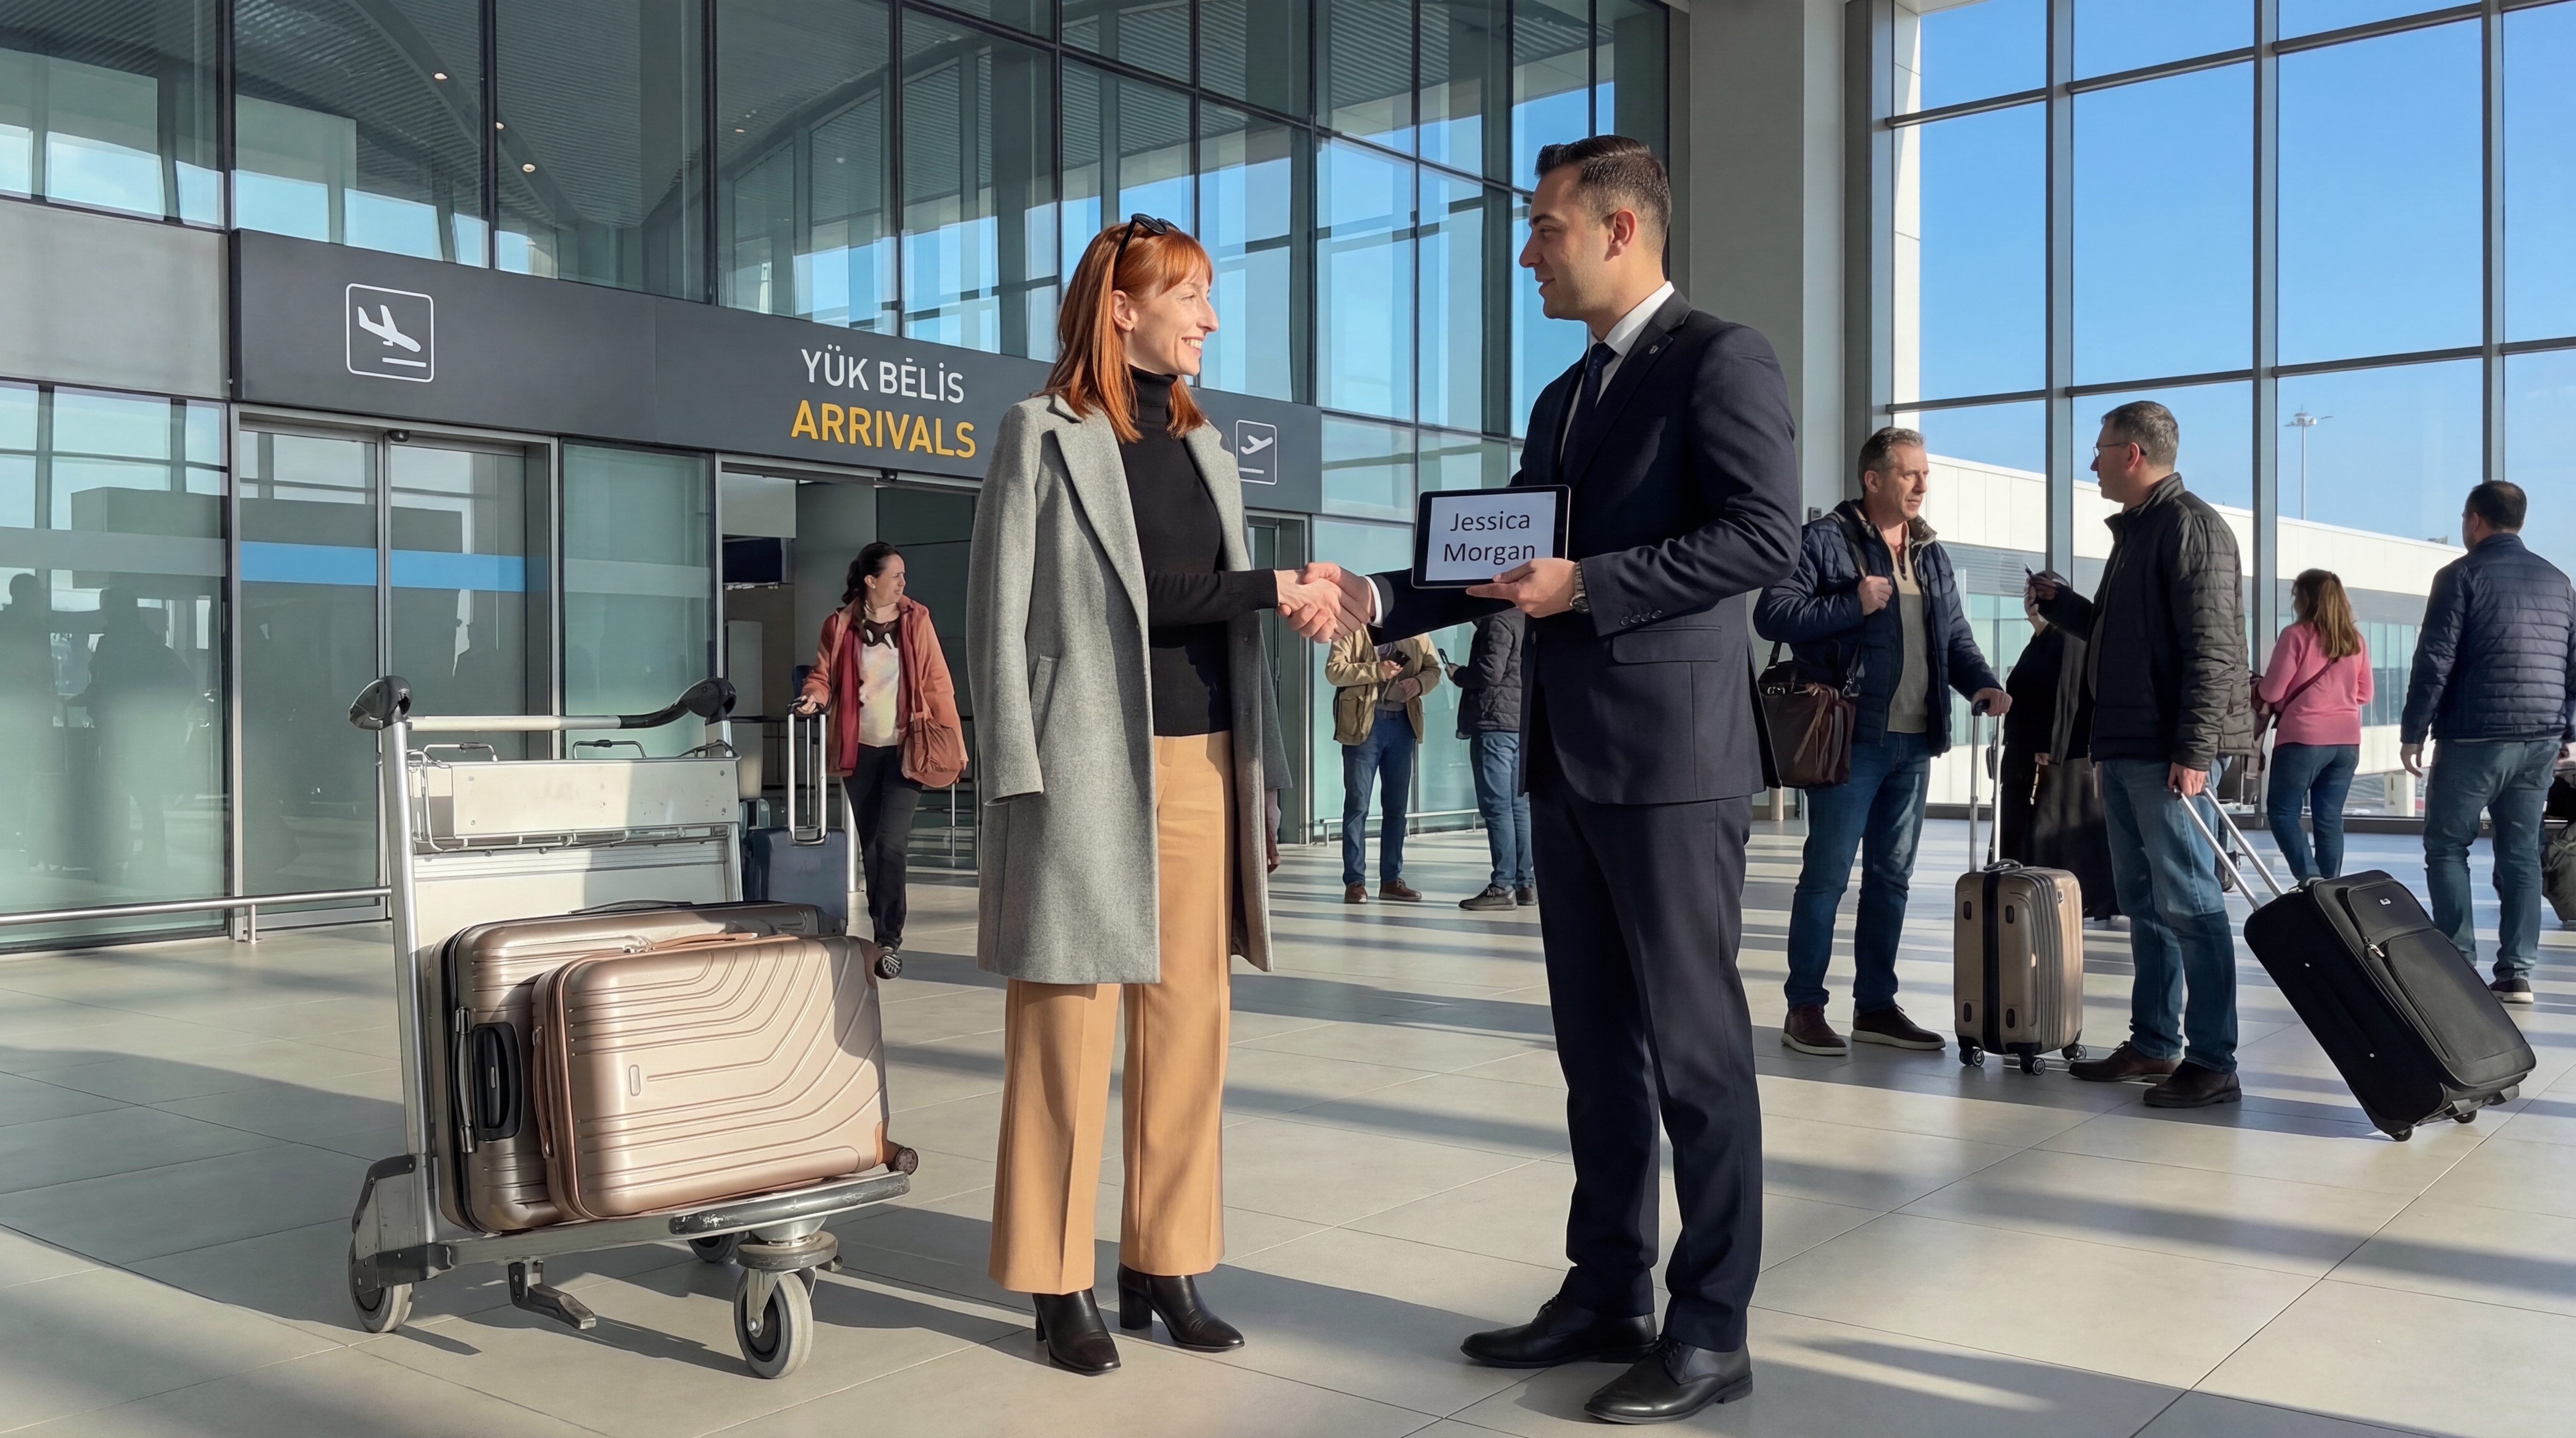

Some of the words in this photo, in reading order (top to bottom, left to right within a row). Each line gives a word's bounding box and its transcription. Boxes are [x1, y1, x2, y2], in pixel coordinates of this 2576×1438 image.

[801, 344, 869, 391] YÜK
[790, 399, 976, 458] ARRIVALS
[1450, 510, 1530, 531] Jessica
[1444, 543, 1535, 565] Morgan
